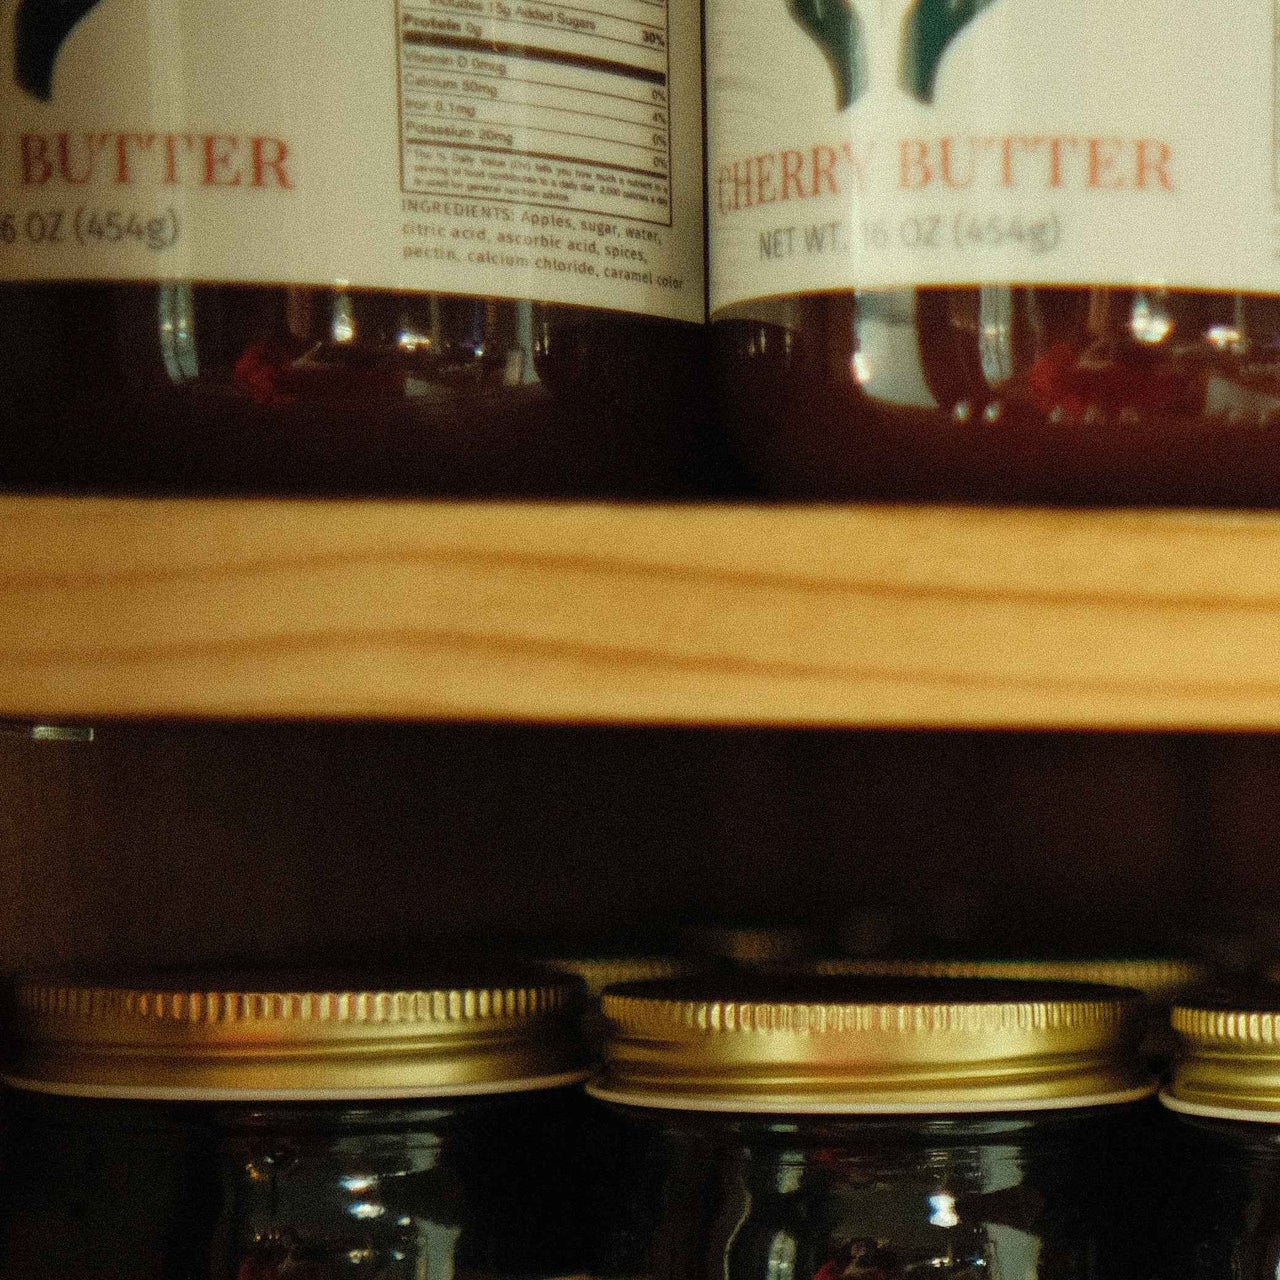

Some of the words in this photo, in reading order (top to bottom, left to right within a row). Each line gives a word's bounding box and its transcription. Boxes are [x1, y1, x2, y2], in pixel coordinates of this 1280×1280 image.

[556, 13, 597, 31] Sugars
[19, 129, 296, 192] BUTTER
[715, 141, 868, 215] CHERRY
[898, 134, 1178, 192] BUTTER
[0, 212, 17, 244] 6
[26, 209, 65, 243] OZ
[74, 205, 179, 252] (454g)
[496, 230, 563, 251] ascorbic
[567, 238, 601, 257] acid,
[604, 244, 649, 264] spices,
[520, 211, 577, 232] Apples,
[580, 217, 622, 239] sugar,
[624, 227, 664, 247] water,
[758, 226, 796, 261] NET
[901, 214, 941, 247] OZ
[952, 210, 1064, 257] (454g)
[534, 256, 600, 280] chloride,
[603, 263, 654, 287] caramel
[656, 271, 686, 292] color
